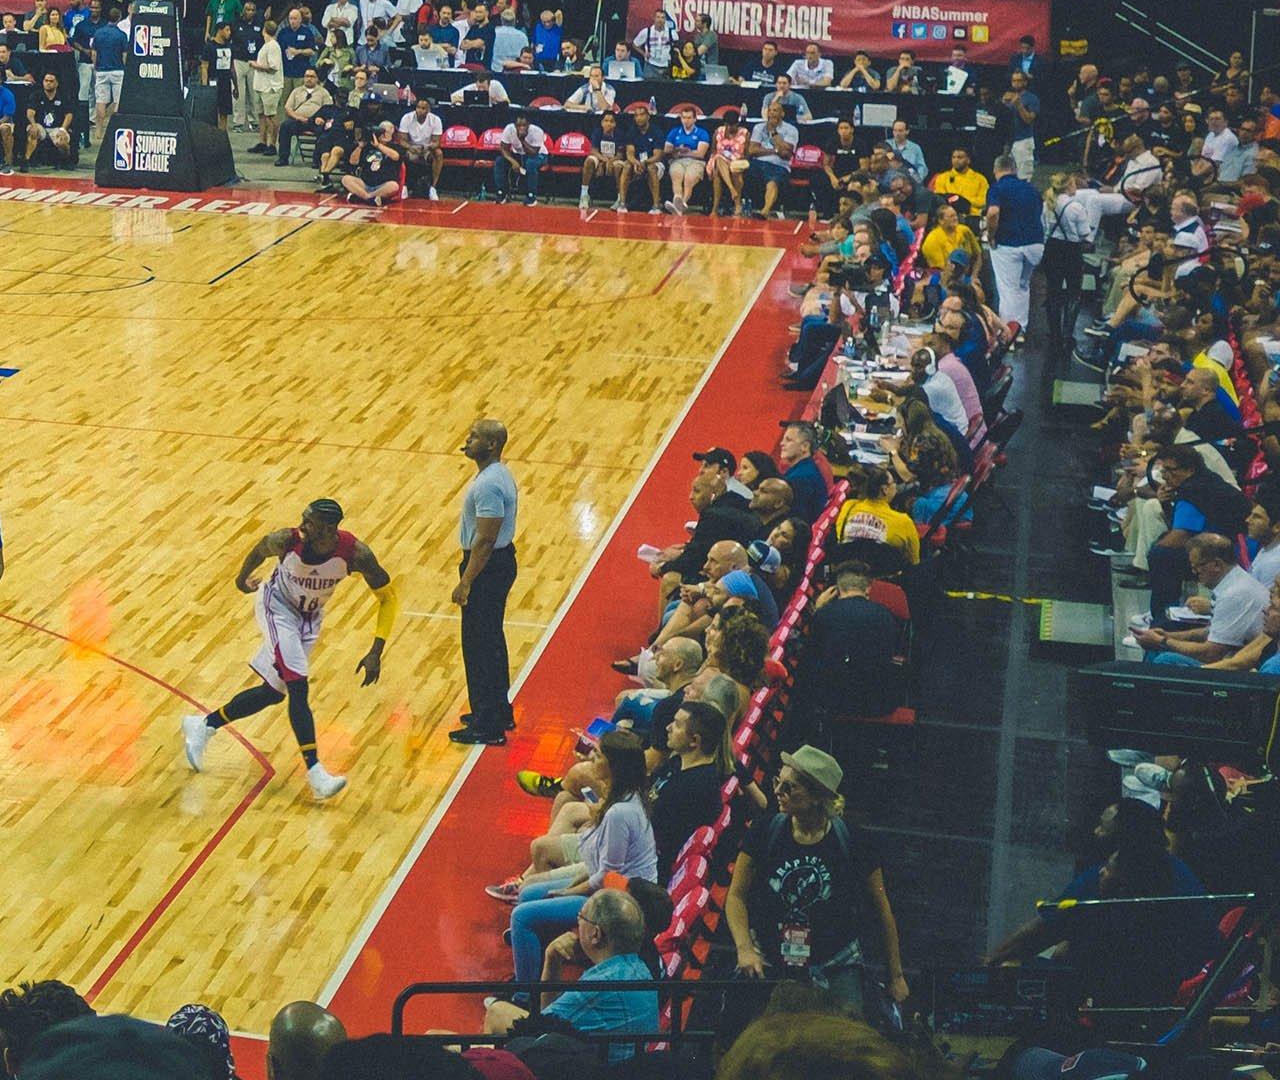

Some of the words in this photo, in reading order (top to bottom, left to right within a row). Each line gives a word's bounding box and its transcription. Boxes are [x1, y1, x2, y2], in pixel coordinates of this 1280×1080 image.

[766, 3, 833, 41] LEAGUE
[892, 5, 989, 24] #NBASummer
[138, 63, 164, 80] @NBA
[135, 134, 177, 156] SUMMER
[134, 153, 170, 173] LEAGUE
[180, 196, 384, 224] LEAGUE
